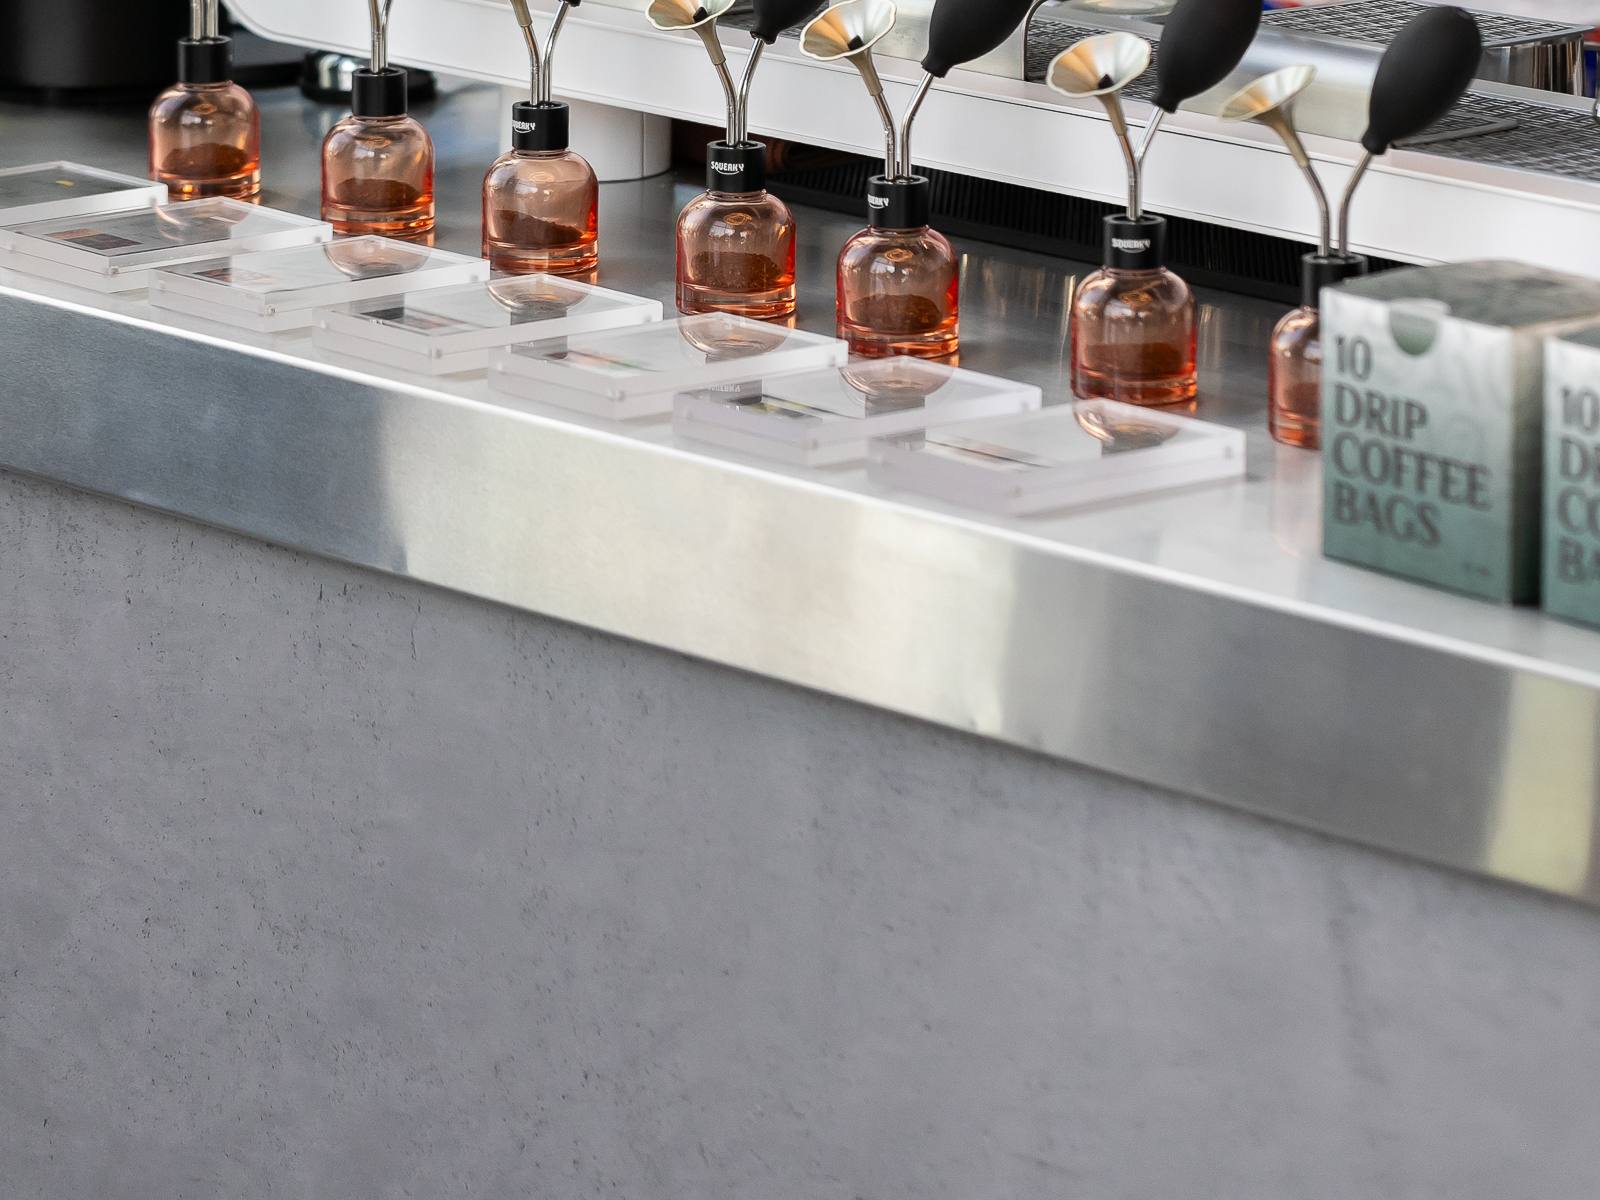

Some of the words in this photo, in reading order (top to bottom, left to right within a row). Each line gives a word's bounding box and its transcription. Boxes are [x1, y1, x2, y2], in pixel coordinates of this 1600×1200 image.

[711, 160, 744, 175] SQUEAKY
[1111, 237, 1151, 254] SQUEAKY
[1334, 334, 1371, 381] 10
[1334, 382, 1428, 442] DRIP
[1332, 431, 1492, 511] COFFEE
[1333, 480, 1442, 548] BAGS
